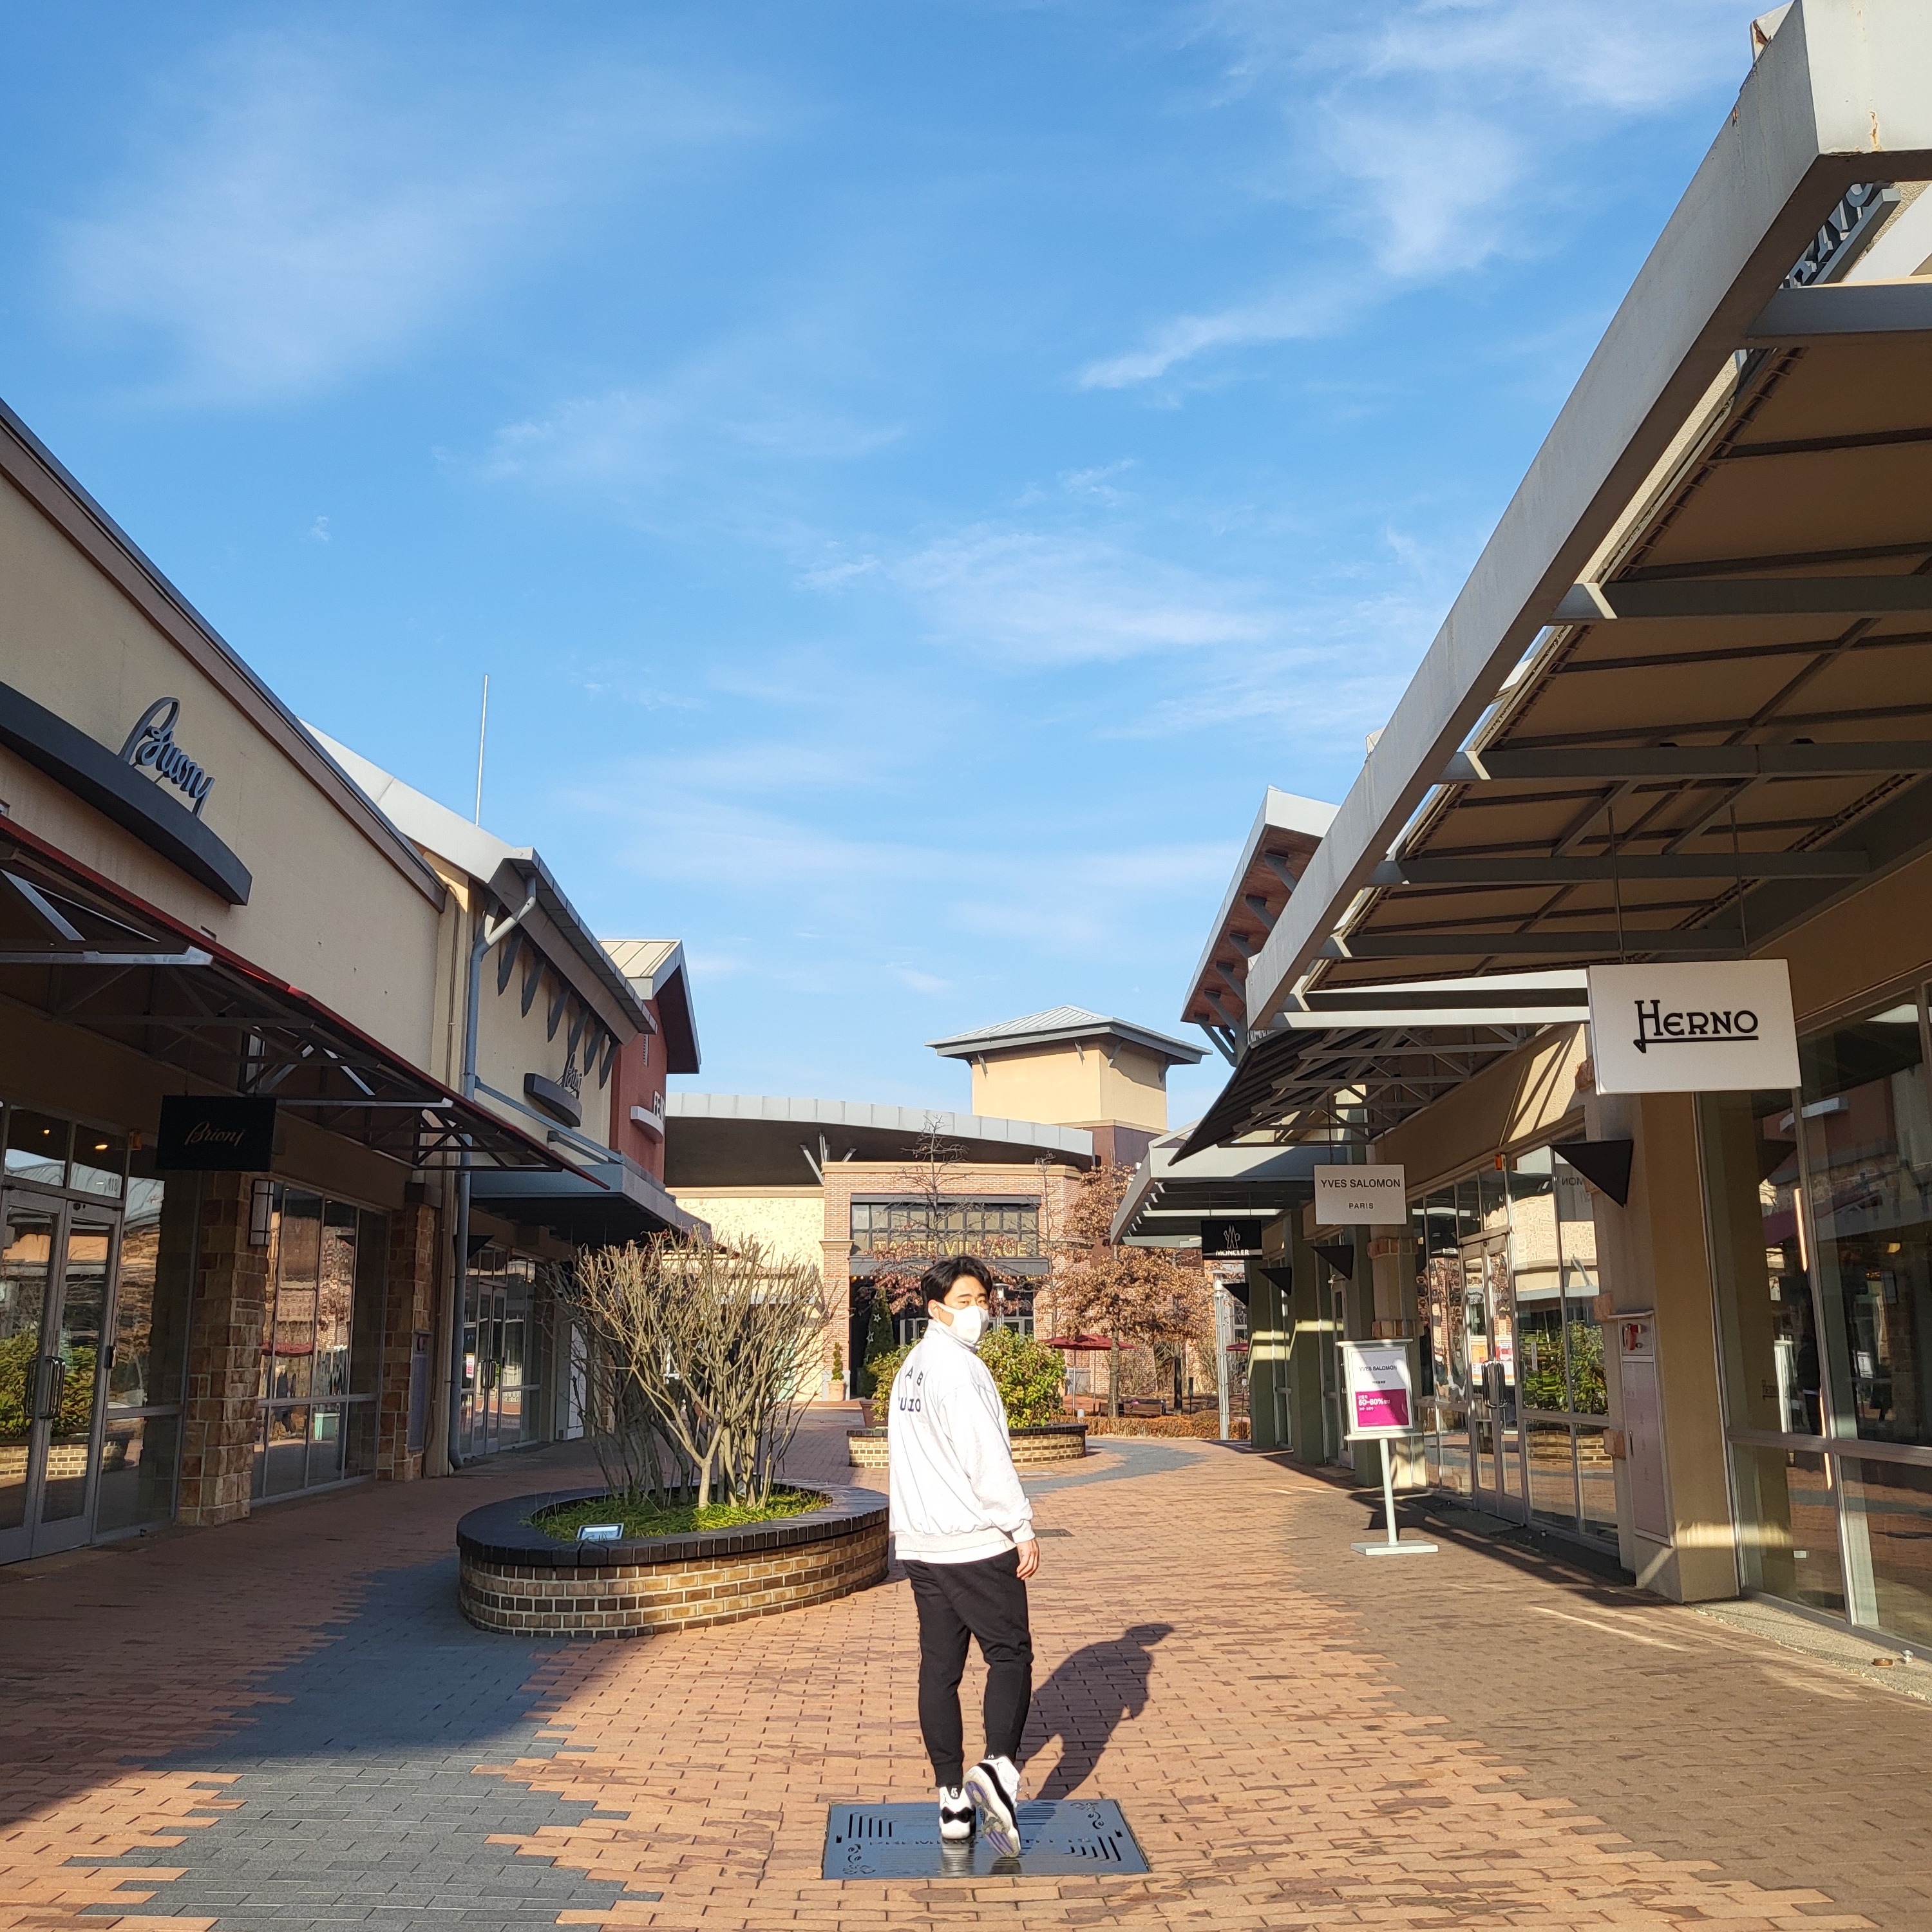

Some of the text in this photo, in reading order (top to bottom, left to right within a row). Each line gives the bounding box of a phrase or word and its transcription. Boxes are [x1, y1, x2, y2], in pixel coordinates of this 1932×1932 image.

[184, 1121, 246, 1146] Brioni
[1320, 1179, 1401, 1188] YVES SALOMON
